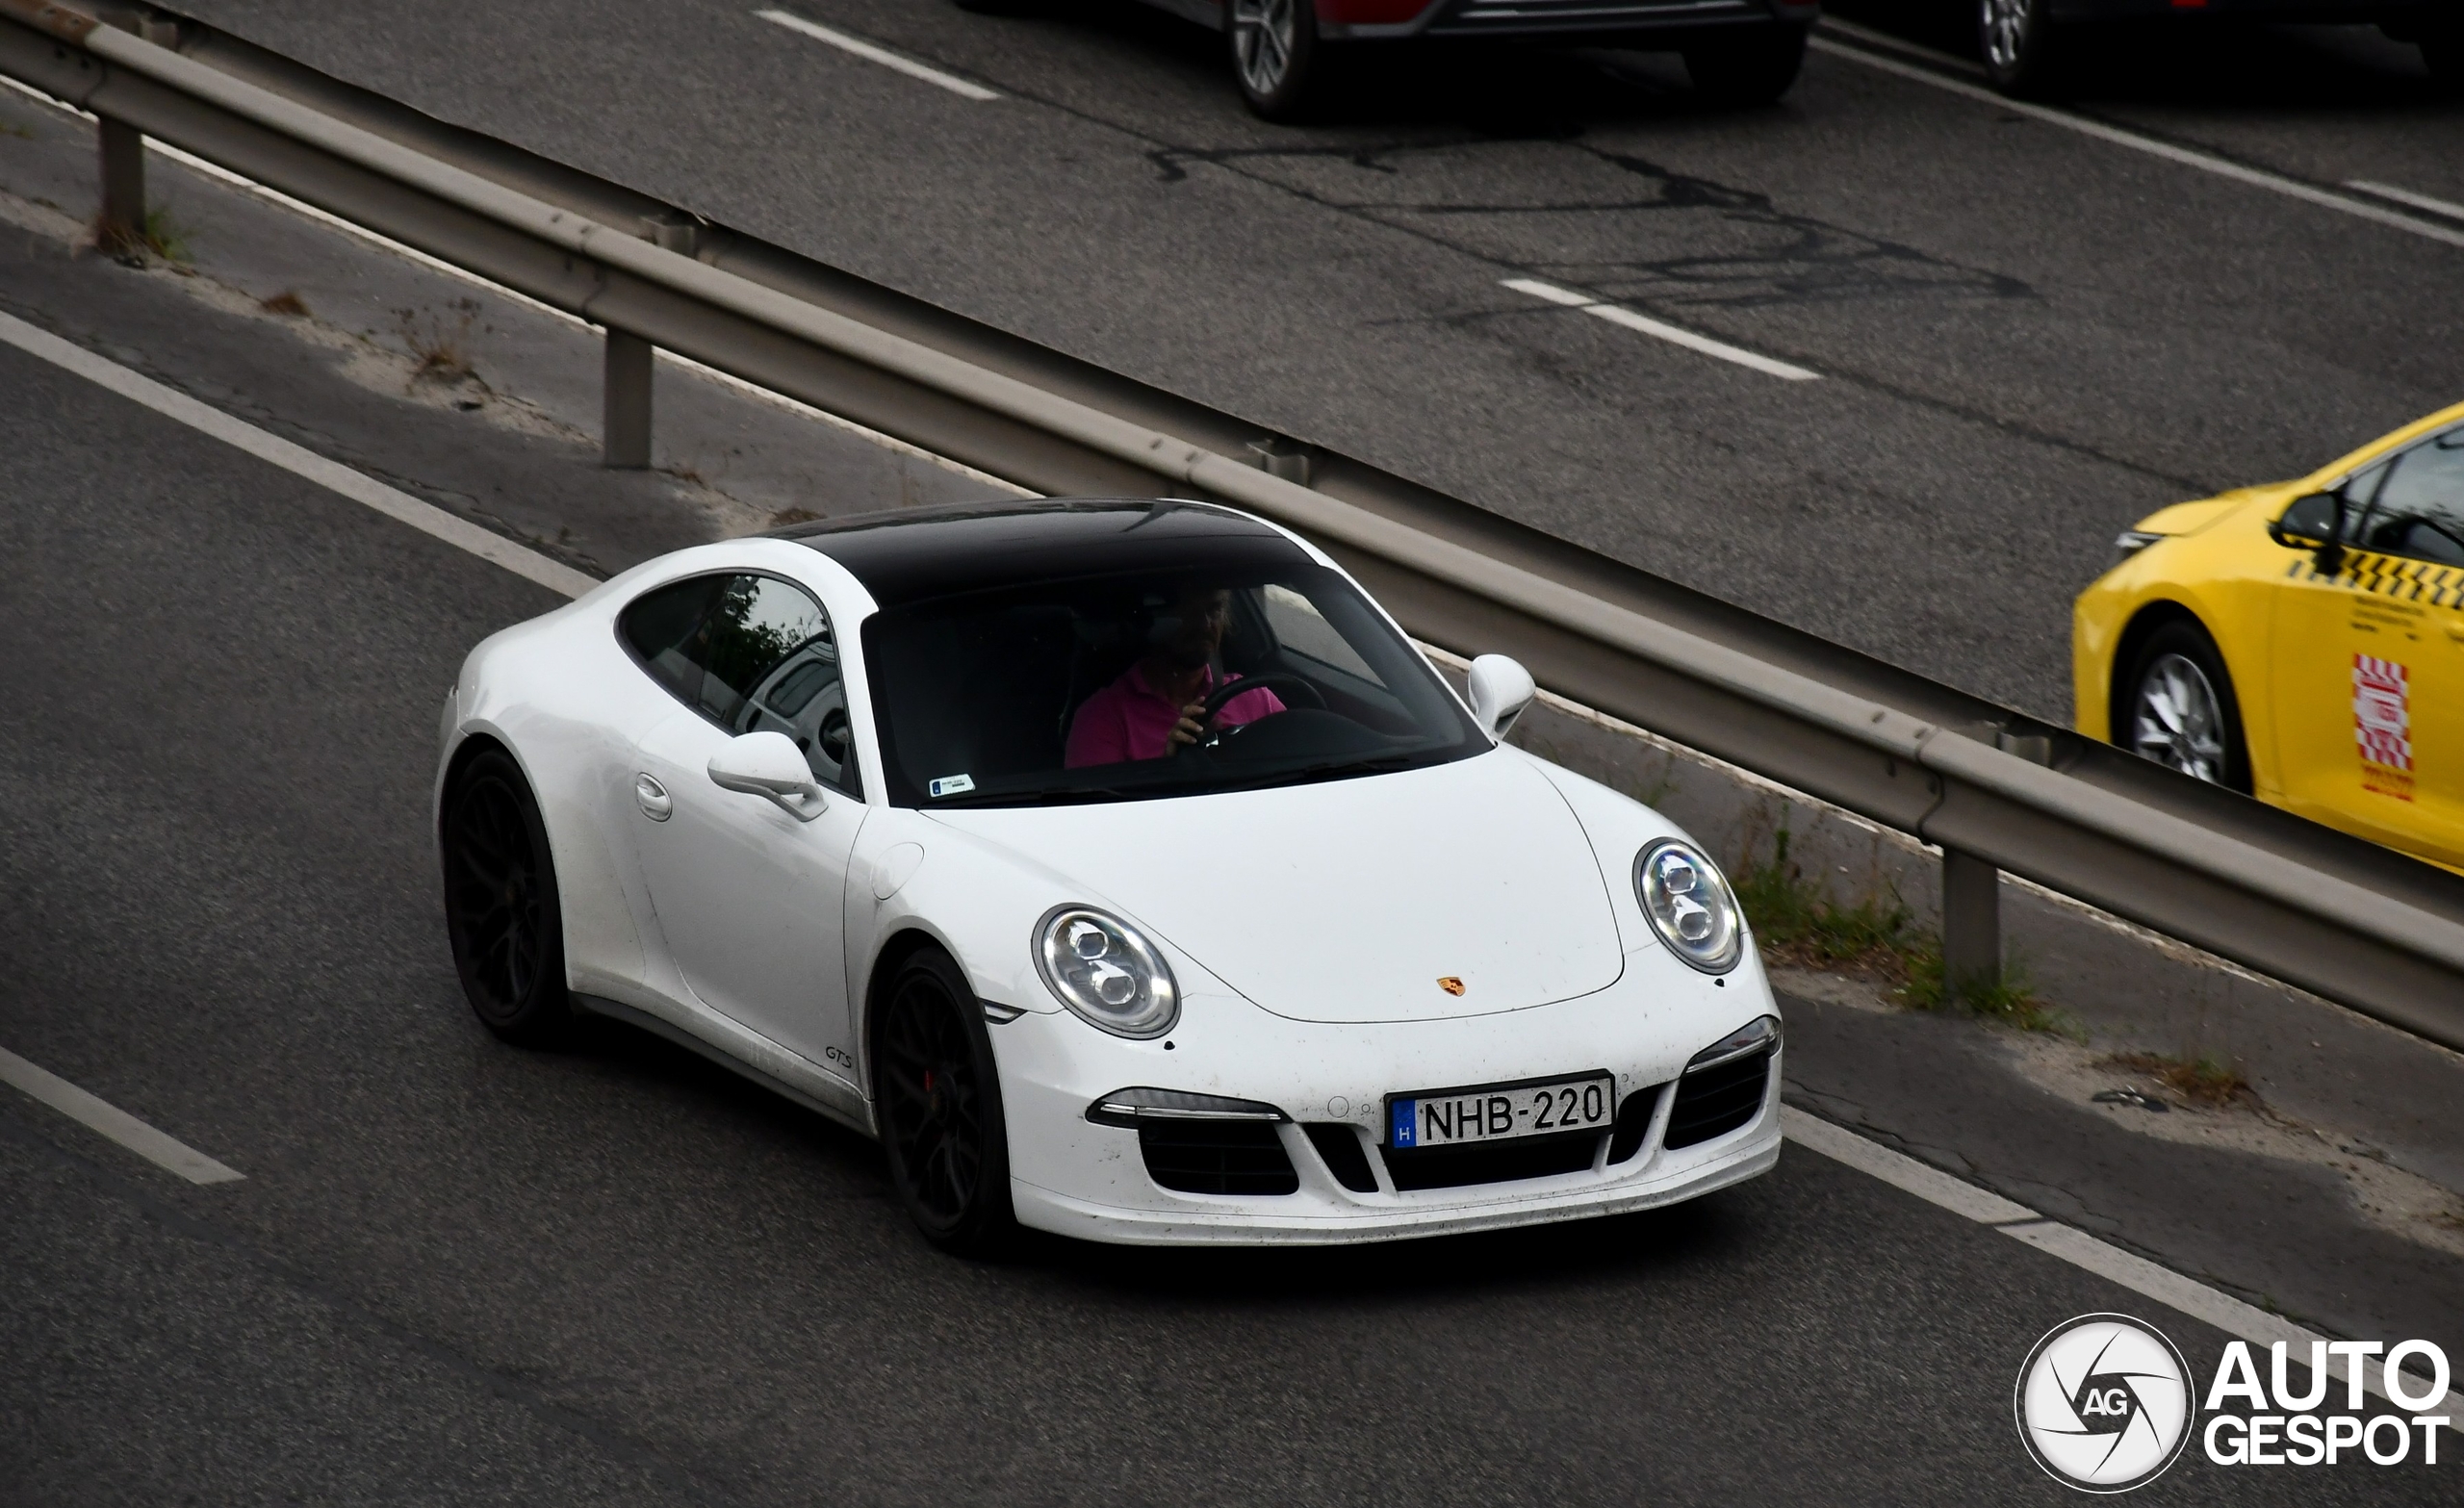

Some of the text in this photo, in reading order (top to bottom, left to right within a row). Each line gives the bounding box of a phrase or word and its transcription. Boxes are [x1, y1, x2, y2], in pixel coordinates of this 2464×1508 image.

[826, 1046, 852, 1068] GTS
[1399, 1085, 1603, 1141] H NHB-220
